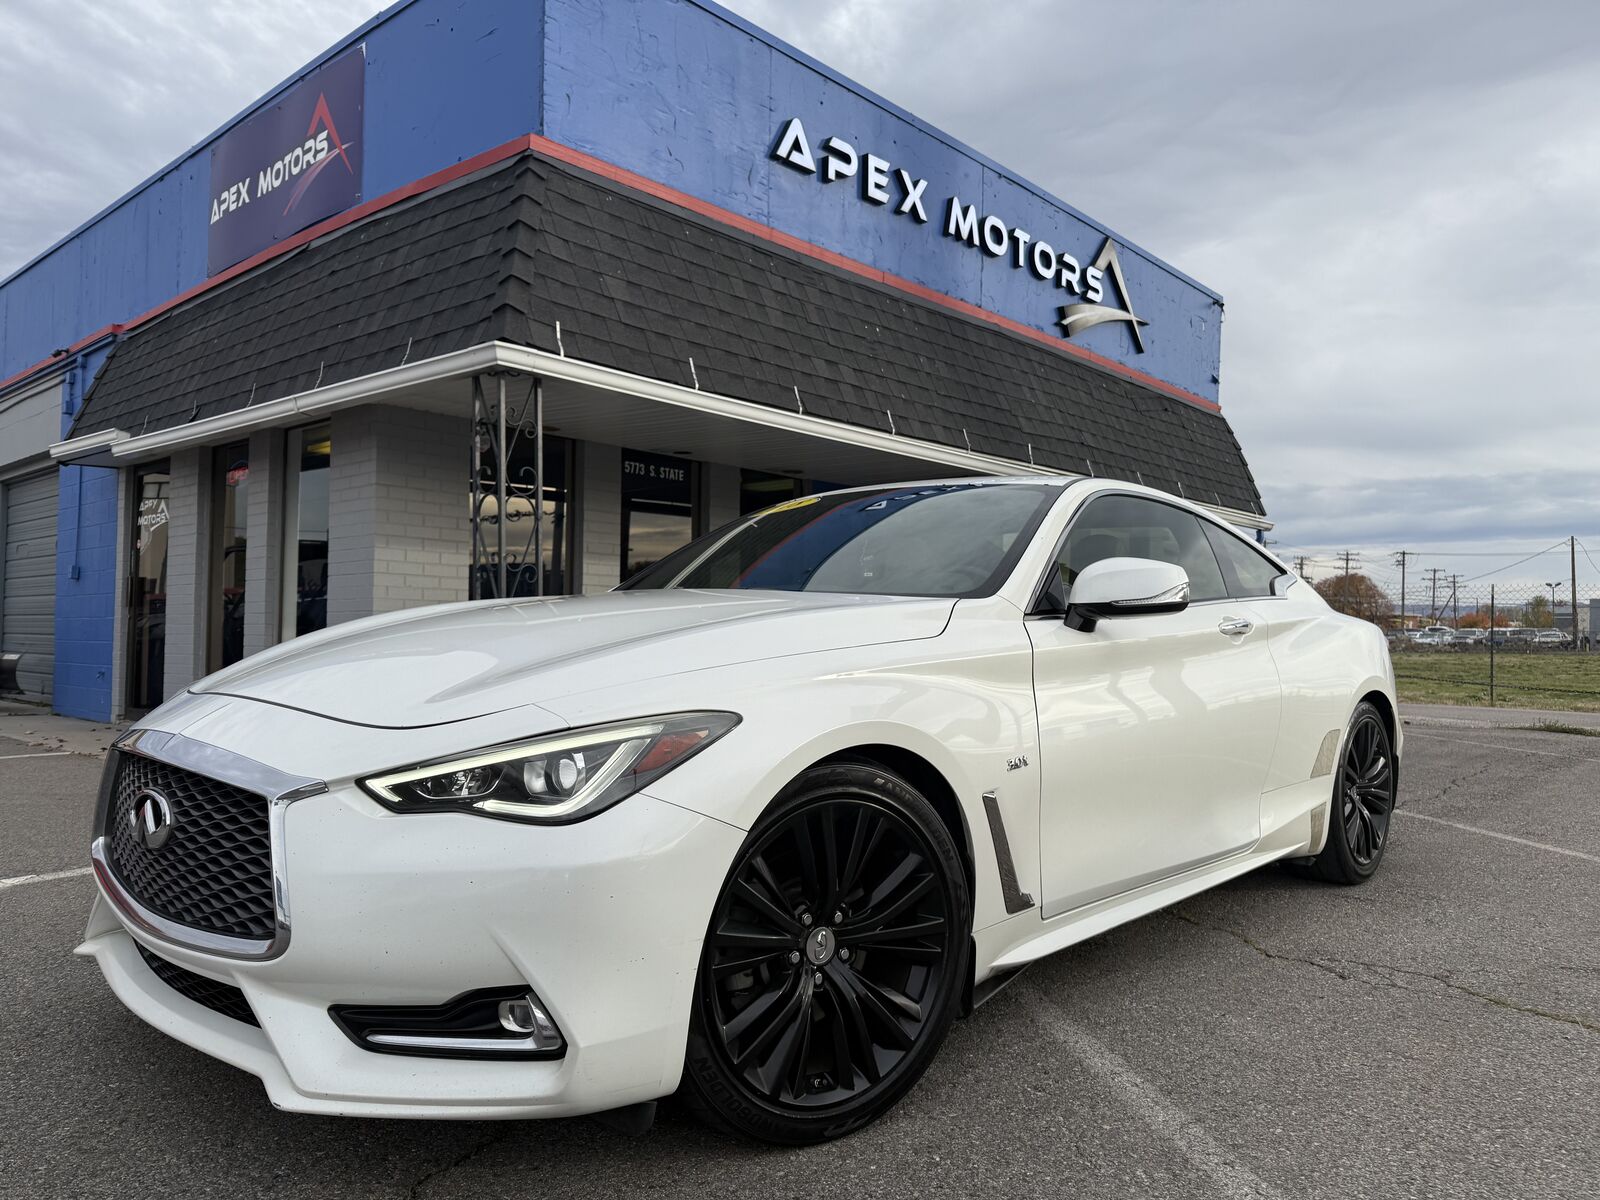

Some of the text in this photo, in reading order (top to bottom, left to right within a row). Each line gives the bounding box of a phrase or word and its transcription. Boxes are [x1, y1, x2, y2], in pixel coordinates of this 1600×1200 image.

[210, 129, 329, 225] APEX MOTORS
[771, 117, 1105, 304] APEX MOTORS
[624, 461, 646, 476] 5773
[659, 466, 685, 481] STATE
[137, 512, 167, 526] MOTORS
